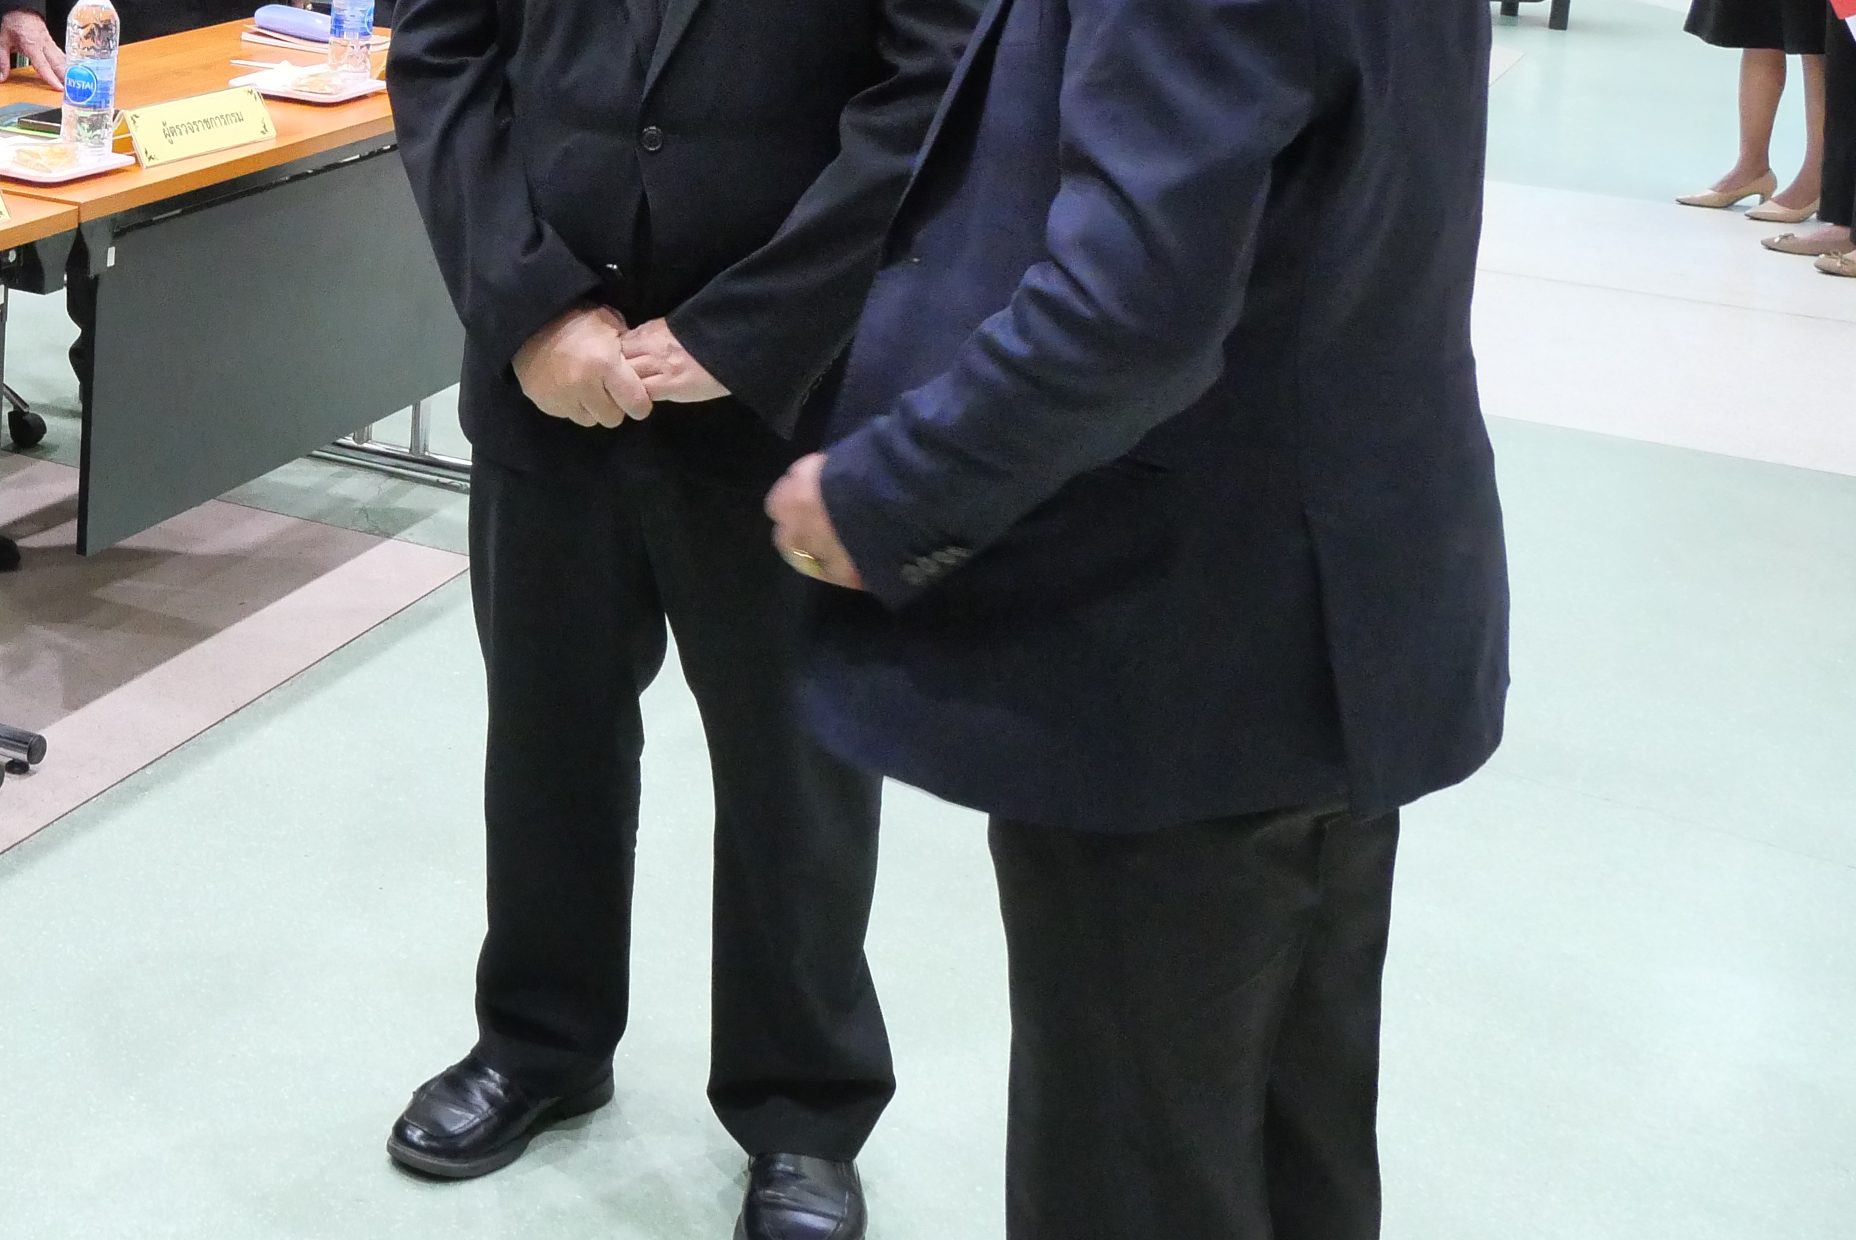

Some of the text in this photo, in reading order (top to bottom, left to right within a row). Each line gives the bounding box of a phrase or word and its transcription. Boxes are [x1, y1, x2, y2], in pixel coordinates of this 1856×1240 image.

[162, 111, 244, 144] ผู้ตรวจราชการกรม
